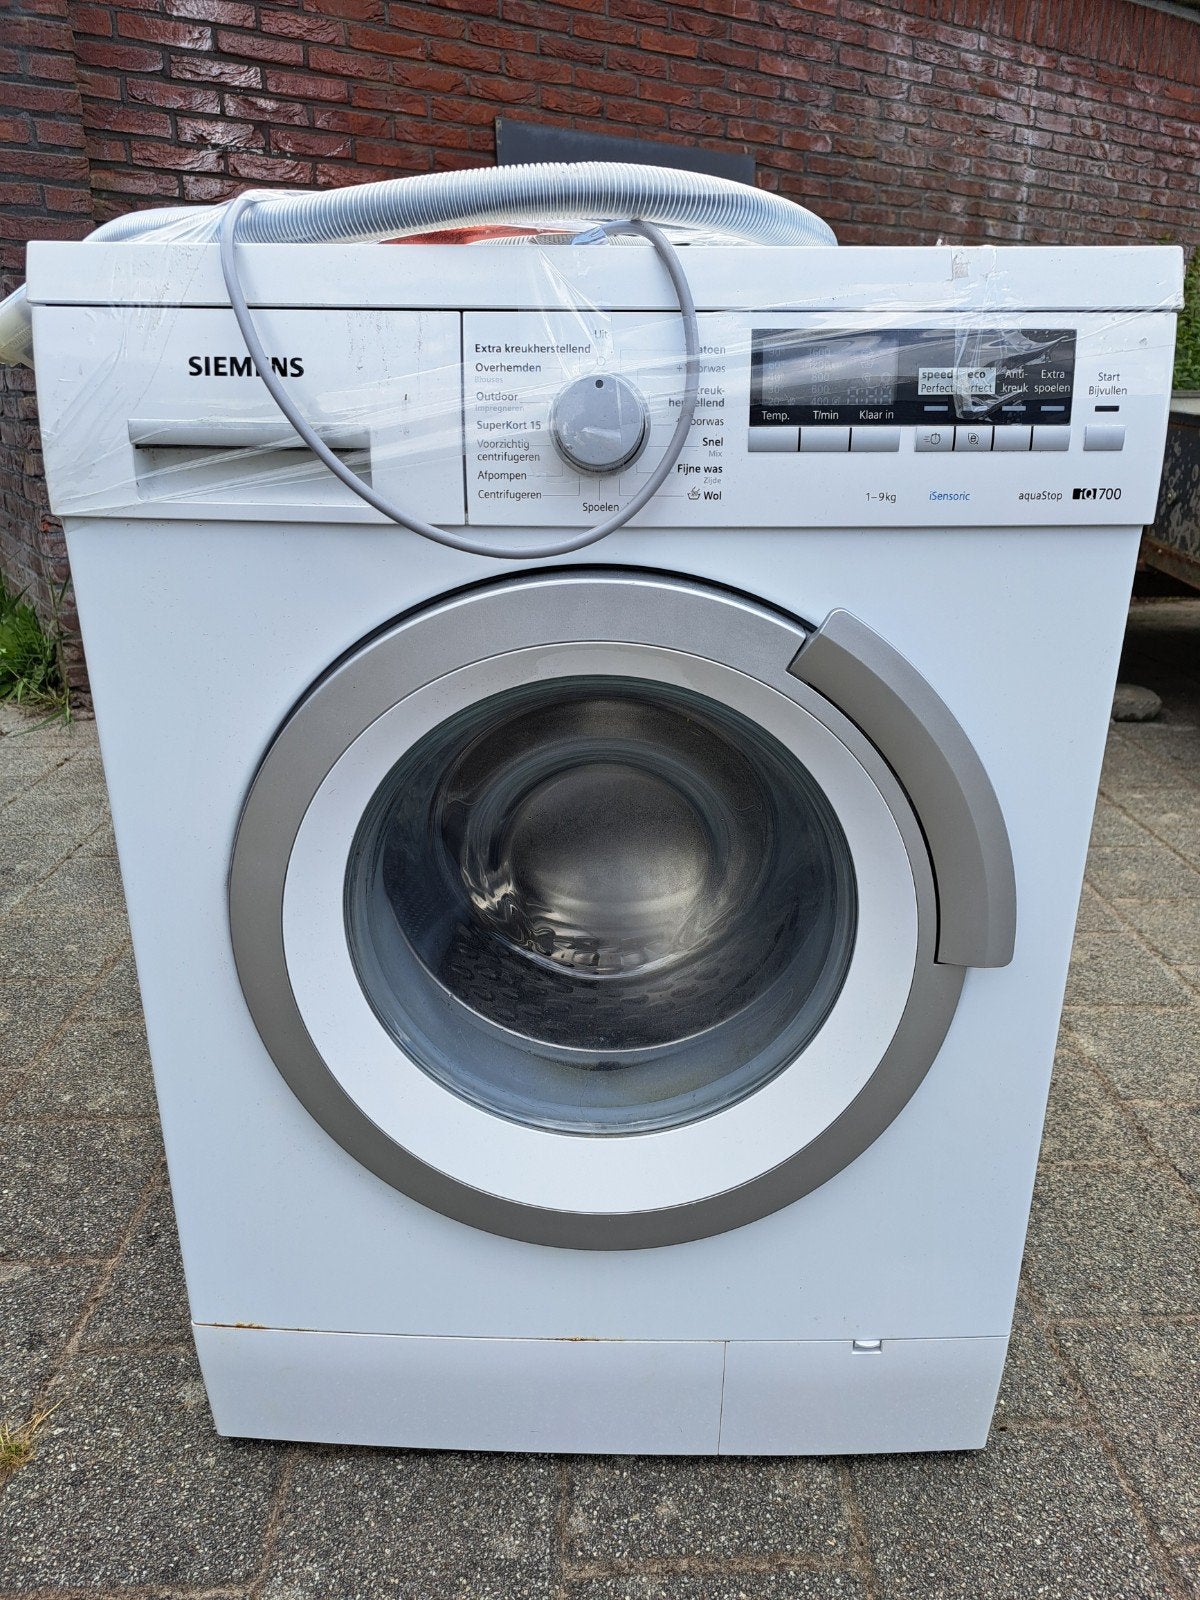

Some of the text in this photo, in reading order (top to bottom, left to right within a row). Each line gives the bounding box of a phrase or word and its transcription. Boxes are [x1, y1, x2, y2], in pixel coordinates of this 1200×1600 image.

[594, 329, 609, 339] Uit
[475, 343, 591, 354] Extra kreukherstellend
[188, 356, 305, 377] SIEMNS
[475, 362, 542, 373] Overhemden
[922, 369, 954, 381] speed
[967, 371, 986, 379] eco
[1005, 368, 1029, 379] Anti-
[1041, 369, 1066, 379] Extra
[1098, 371, 1121, 382] Start
[696, 385, 725, 395] reuk-
[920, 383, 954, 393] Perfect
[1002, 382, 1029, 393] kreuk
[1034, 382, 1071, 395] spoelen
[1088, 385, 1128, 398] Bijvullen
[476, 391, 518, 402] Outdoor
[762, 410, 790, 421] Temp.
[813, 410, 839, 420] T/min
[859, 410, 894, 420] Klaar in
[477, 420, 542, 431] SuperKort 15
[687, 418, 725, 426] oorwas
[477, 439, 530, 451] Voorzichtig
[703, 437, 724, 447] Snel
[477, 452, 541, 464] centrifugeren
[708, 450, 723, 458] Mix
[677, 463, 723, 476] Fijne was
[477, 470, 527, 481] Afpompen
[703, 476, 722, 486] Zijde
[478, 489, 542, 502] Centrifugeren
[704, 490, 722, 501] Wol
[929, 490, 971, 501] iSensoric
[1018, 490, 1063, 502] aquaStop
[582, 502, 620, 514] Spoelen
